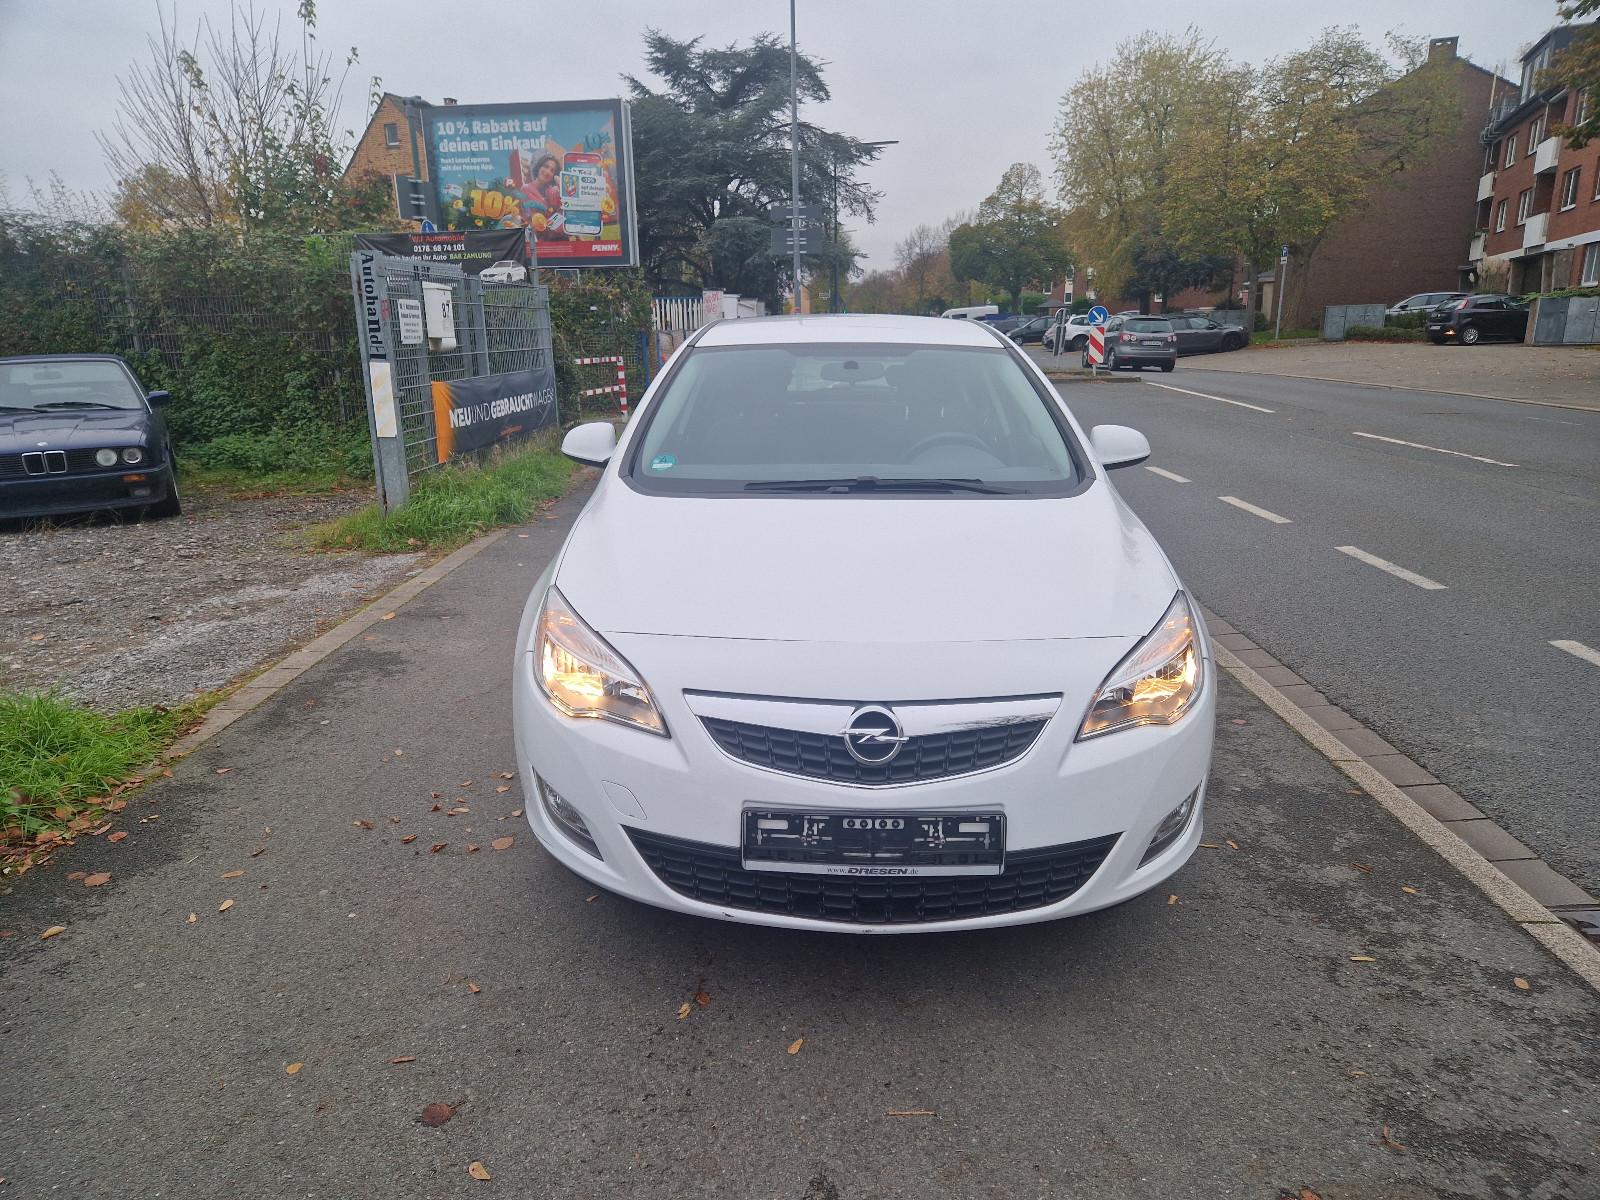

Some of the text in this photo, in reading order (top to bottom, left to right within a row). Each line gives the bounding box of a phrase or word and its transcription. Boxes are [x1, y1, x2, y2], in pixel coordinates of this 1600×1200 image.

[437, 117, 548, 135] 10 % Rabatt auf
[439, 135, 546, 153] deinen Einkauf
[413, 244, 430, 253] 0178
[453, 243, 465, 251] 101
[592, 244, 618, 252] PENNY
[826, 866, 919, 876] www.DRESEN.de
